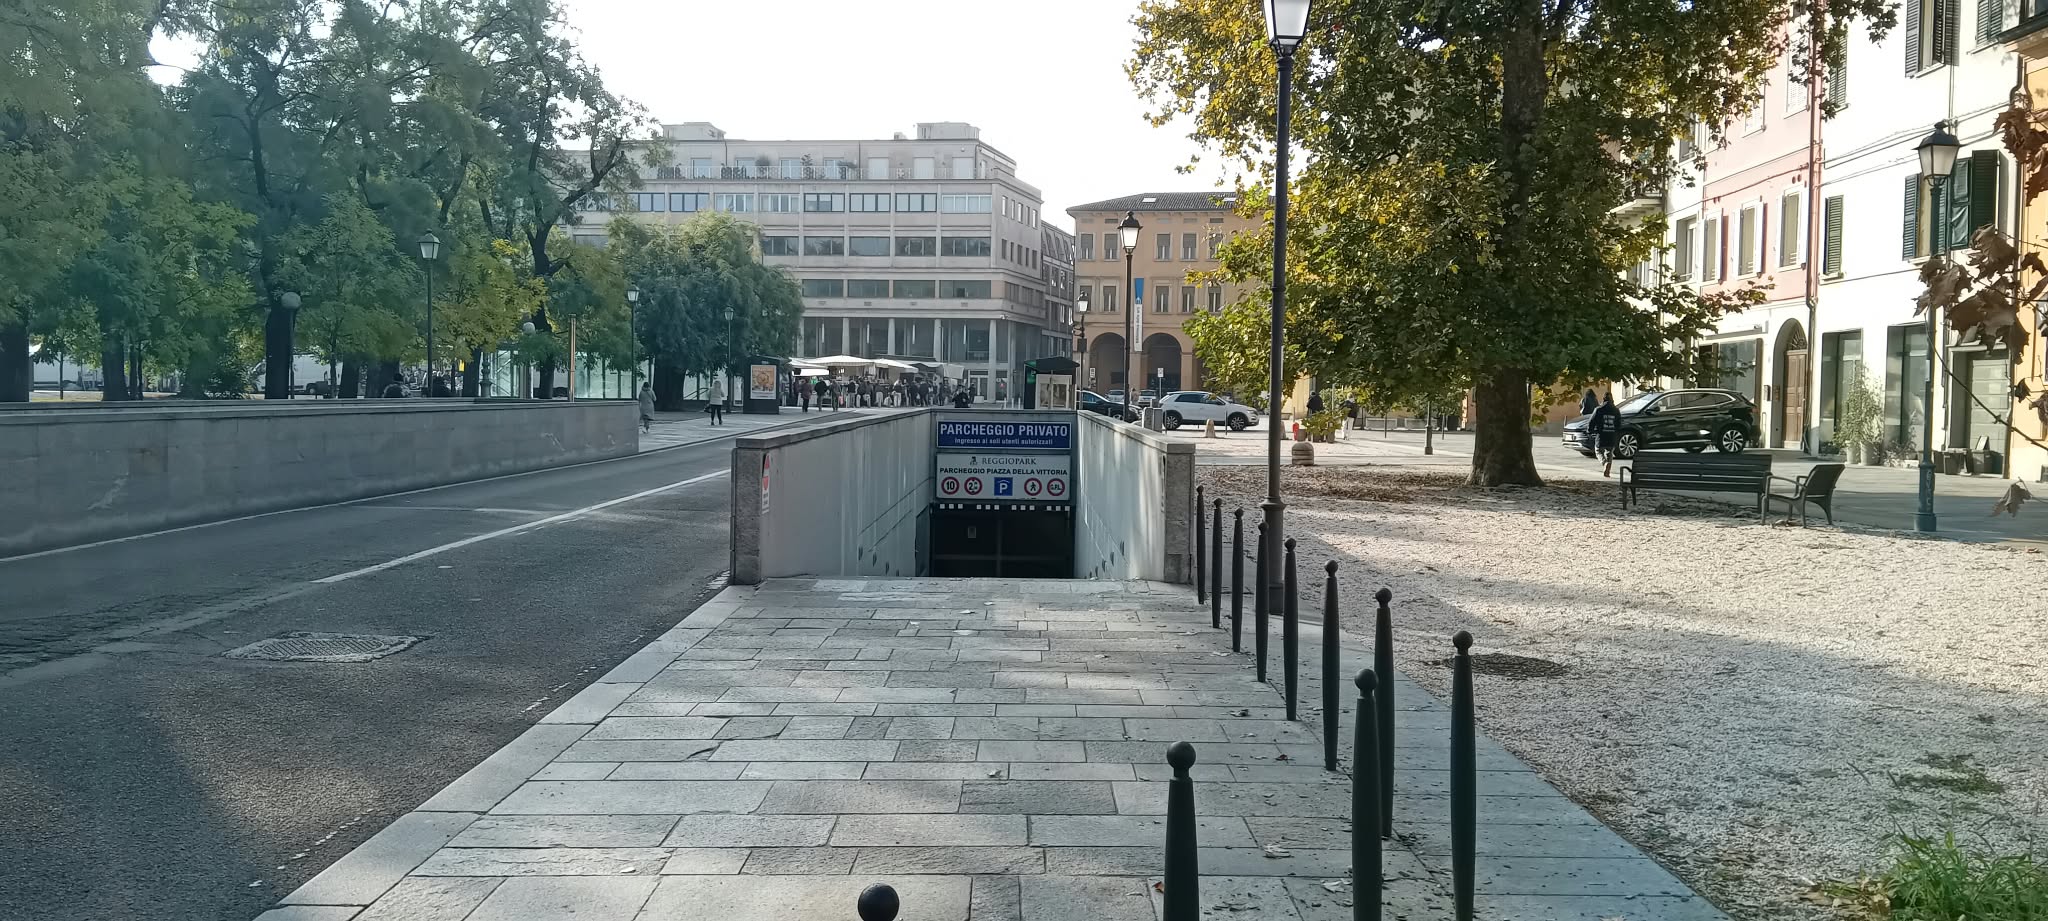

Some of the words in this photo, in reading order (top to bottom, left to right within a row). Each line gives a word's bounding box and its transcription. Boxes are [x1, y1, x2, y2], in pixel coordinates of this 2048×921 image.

[940, 424, 1014, 435] PARCHEGGIO
[1019, 425, 1068, 436] PRIVATO
[982, 457, 1037, 465] REGGIOPARK
[946, 481, 955, 490] 10
[999, 483, 1008, 494] P
